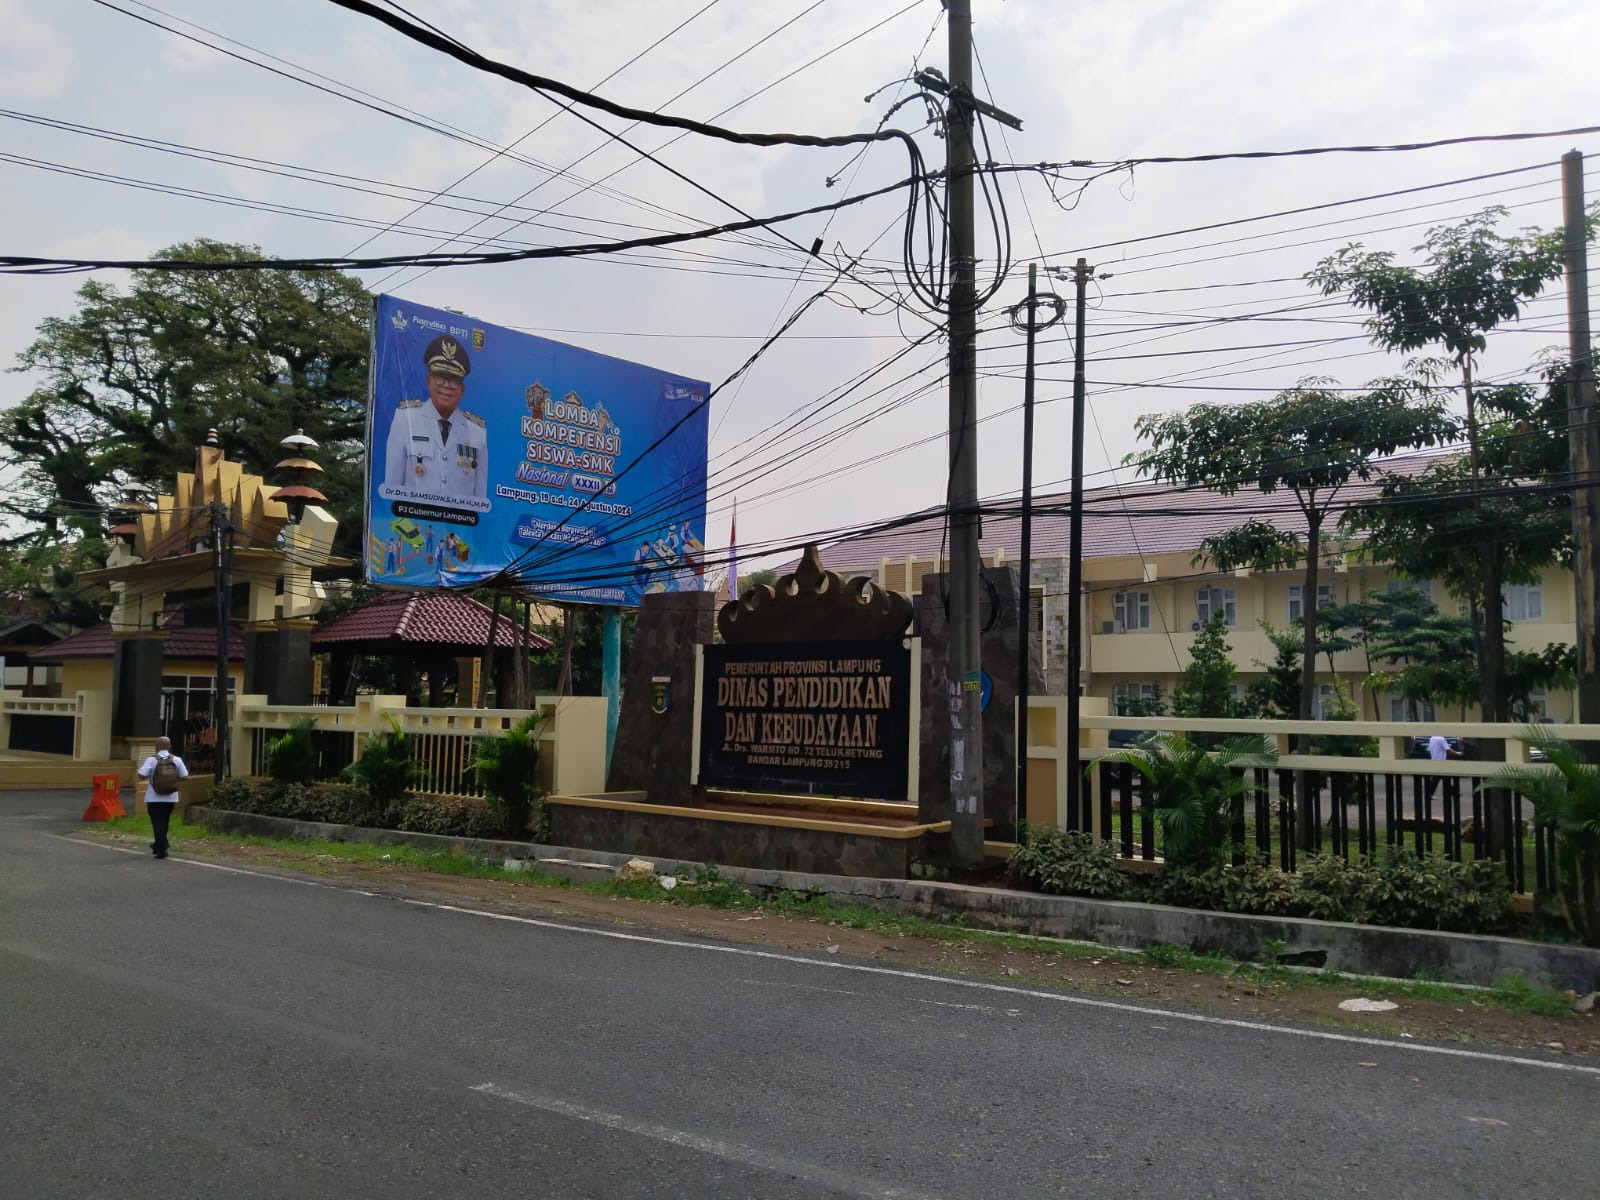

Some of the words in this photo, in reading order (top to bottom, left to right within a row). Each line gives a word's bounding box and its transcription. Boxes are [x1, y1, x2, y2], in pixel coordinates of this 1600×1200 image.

[449, 326, 468, 338] BPTI
[545, 400, 600, 428] LOMBA
[522, 417, 620, 455] KOMPETENSI
[527, 442, 613, 474] SISWA-SMK
[517, 463, 569, 487] Nasional
[574, 476, 601, 491] XXXII
[408, 506, 442, 517] Gubernur
[443, 511, 476, 524] Lampung
[496, 485, 539, 503] Lampung,
[541, 493, 549, 502] 19
[569, 497, 579, 507] 24
[581, 500, 612, 513] Agustus
[613, 505, 631, 517] 2024
[725, 661, 783, 675] PEMERINTAH
[783, 660, 828, 674] PROVINSI
[829, 659, 881, 673] LAMPUNG
[717, 676, 769, 708] DINAS
[772, 676, 892, 709] PENDIDIKAN
[724, 711, 757, 742] DAN
[761, 712, 878, 747] KEBUDAYAAN
[747, 754, 781, 766] BANDAR
[781, 756, 823, 768] LAMPUNG
[823, 759, 851, 769] 35215
[750, 744, 786, 754] WARSITO
[804, 747, 814, 756] 72
